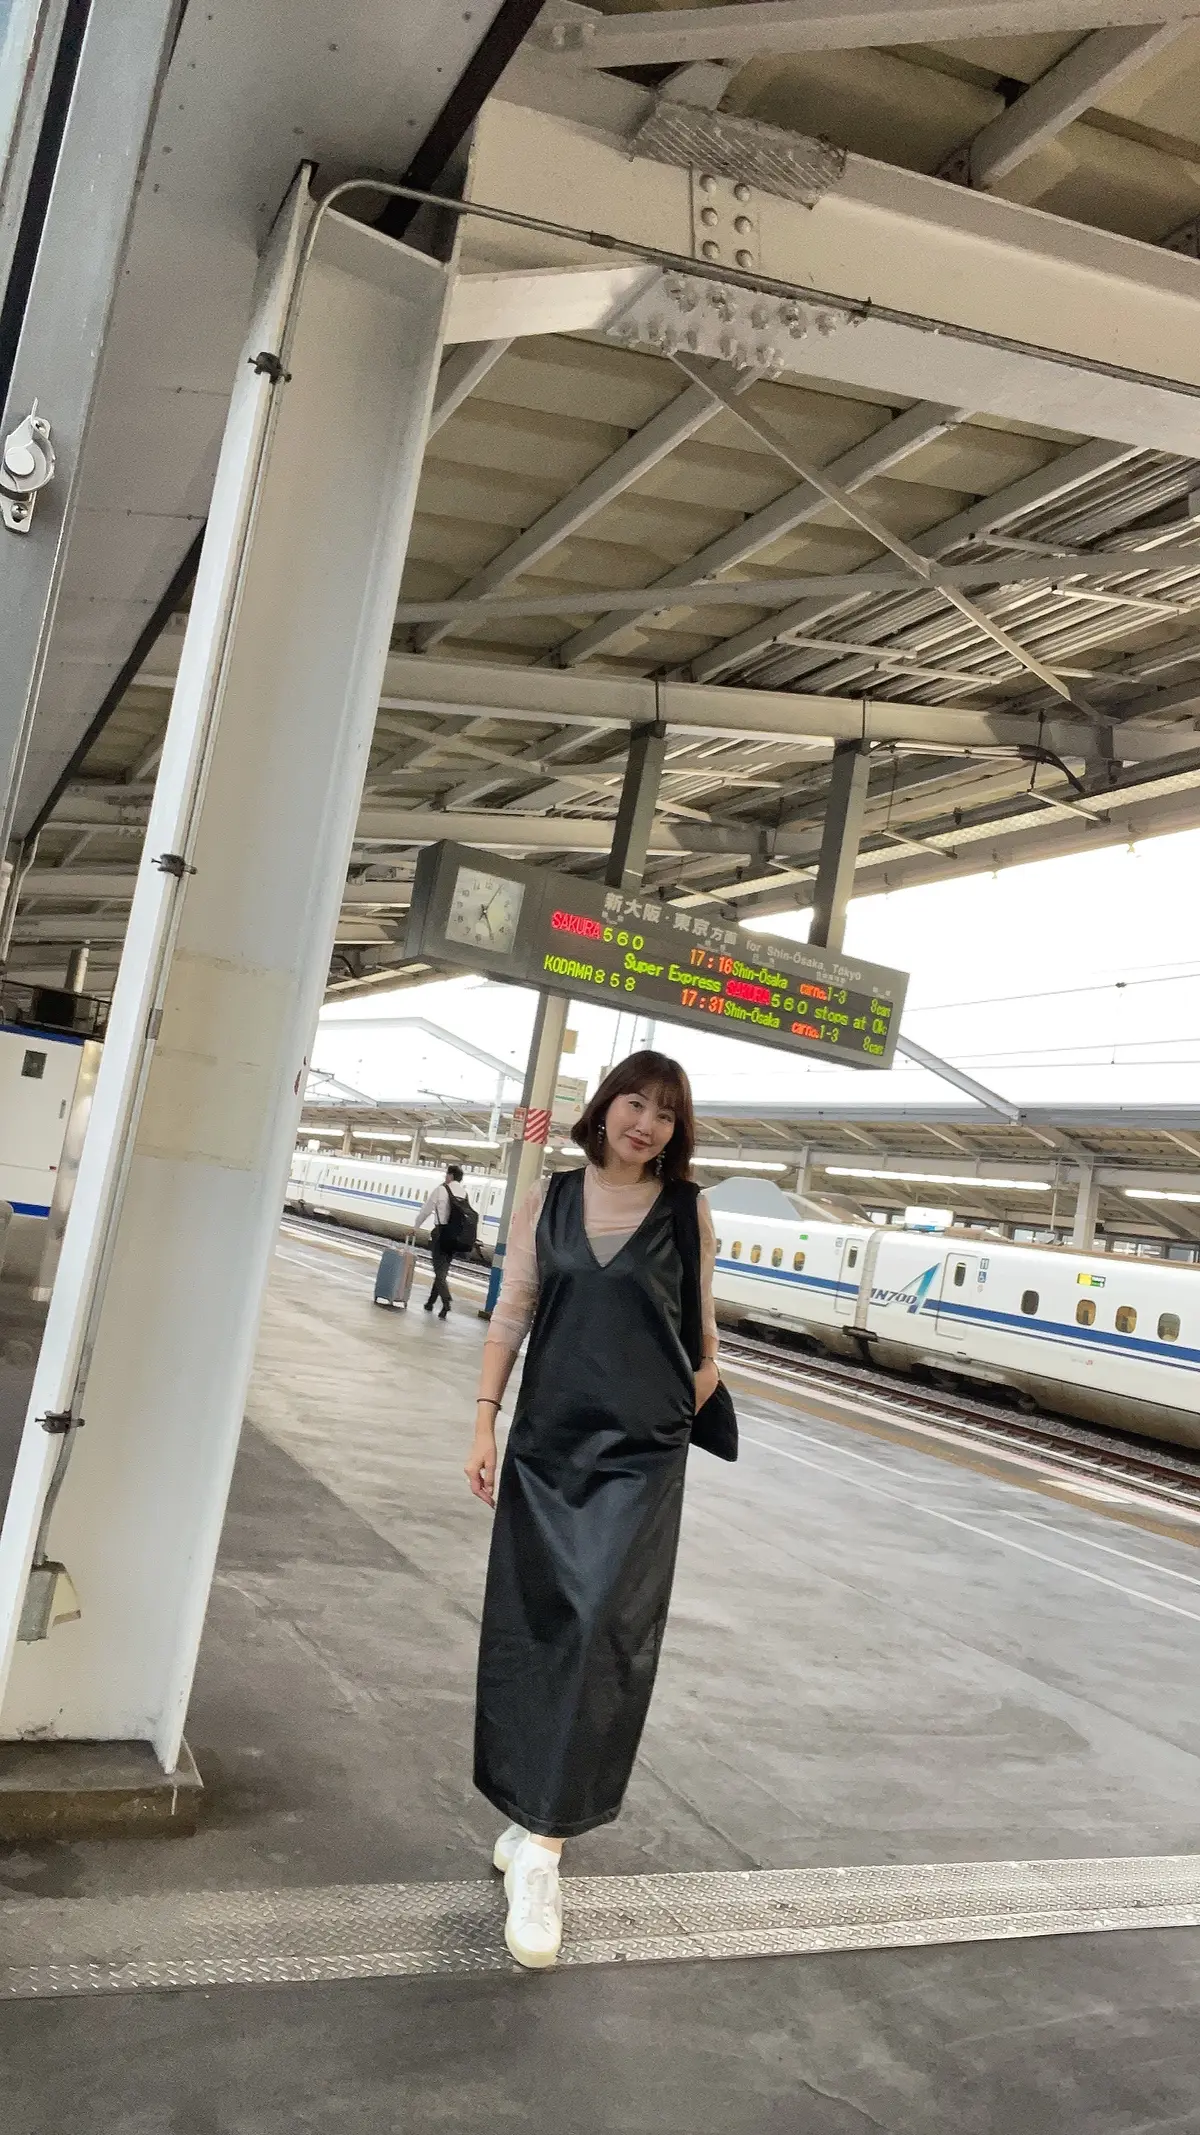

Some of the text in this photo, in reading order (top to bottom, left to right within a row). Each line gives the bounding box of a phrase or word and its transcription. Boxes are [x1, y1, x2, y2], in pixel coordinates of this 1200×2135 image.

[551, 910, 602, 940] SAKURA
[690, 948, 734, 975] 17:16
[746, 940, 761, 952] for
[543, 954, 594, 981] KODAMA
[681, 988, 725, 1014] 17:31
[624, 952, 664, 977] Super
[668, 963, 722, 993] Express
[814, 1006, 849, 1027] stops
[853, 1016, 867, 1031] at
